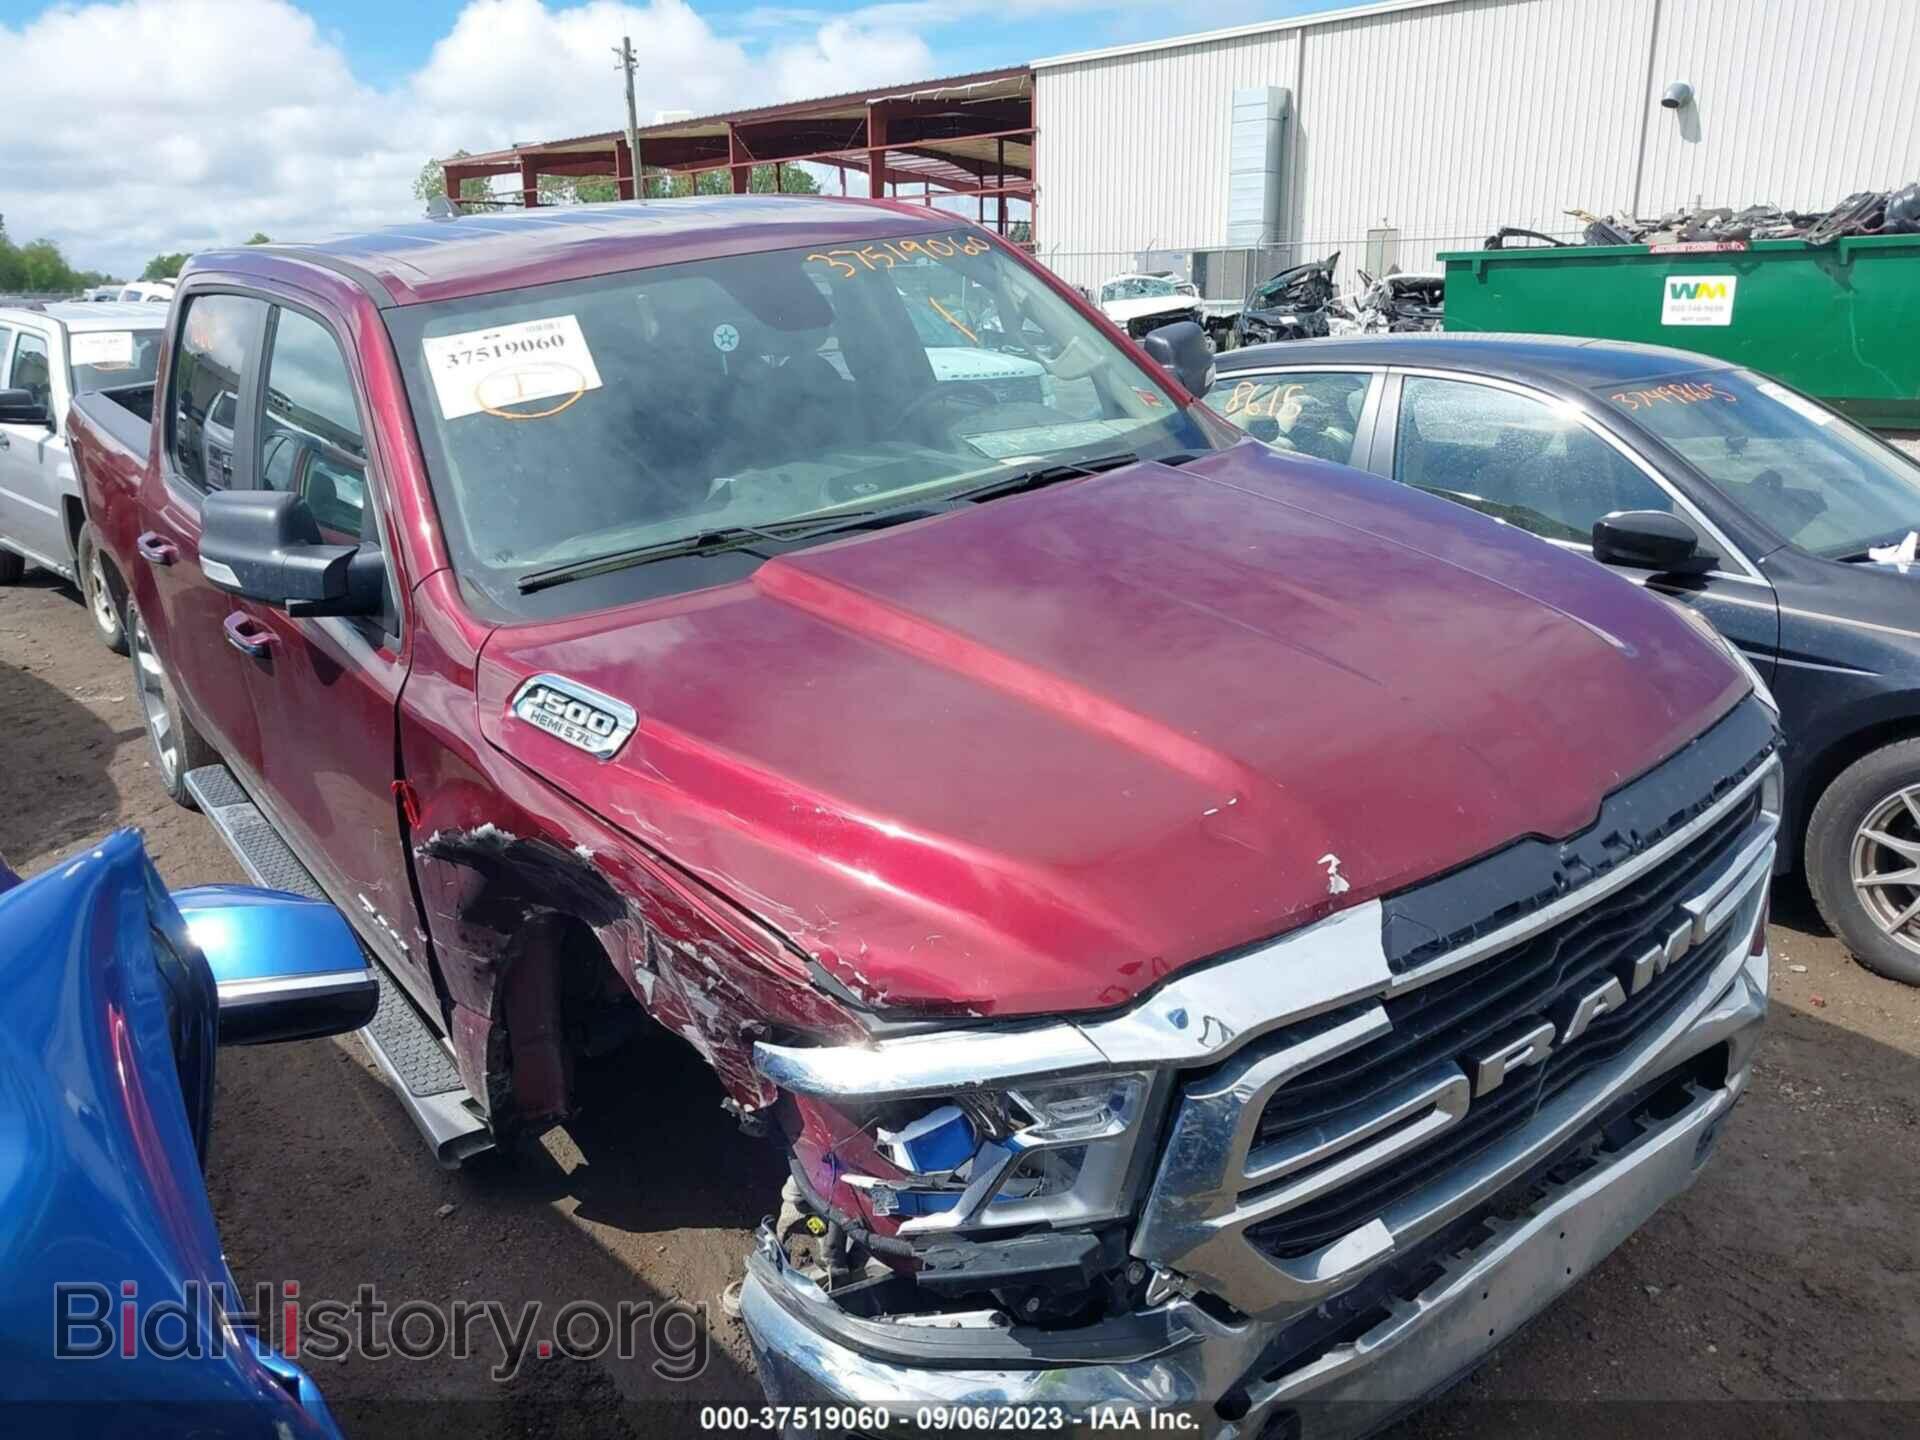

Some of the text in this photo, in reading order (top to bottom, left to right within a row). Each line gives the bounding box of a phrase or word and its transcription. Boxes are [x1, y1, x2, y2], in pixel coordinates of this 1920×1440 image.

[807, 235, 990, 278] 37519060
[1670, 283, 1726, 299] WM
[446, 333, 566, 369] 37519060
[526, 687, 617, 738] 1500
[529, 710, 593, 747] HEMI 5.7L
[1473, 917, 1693, 1099] RAM
